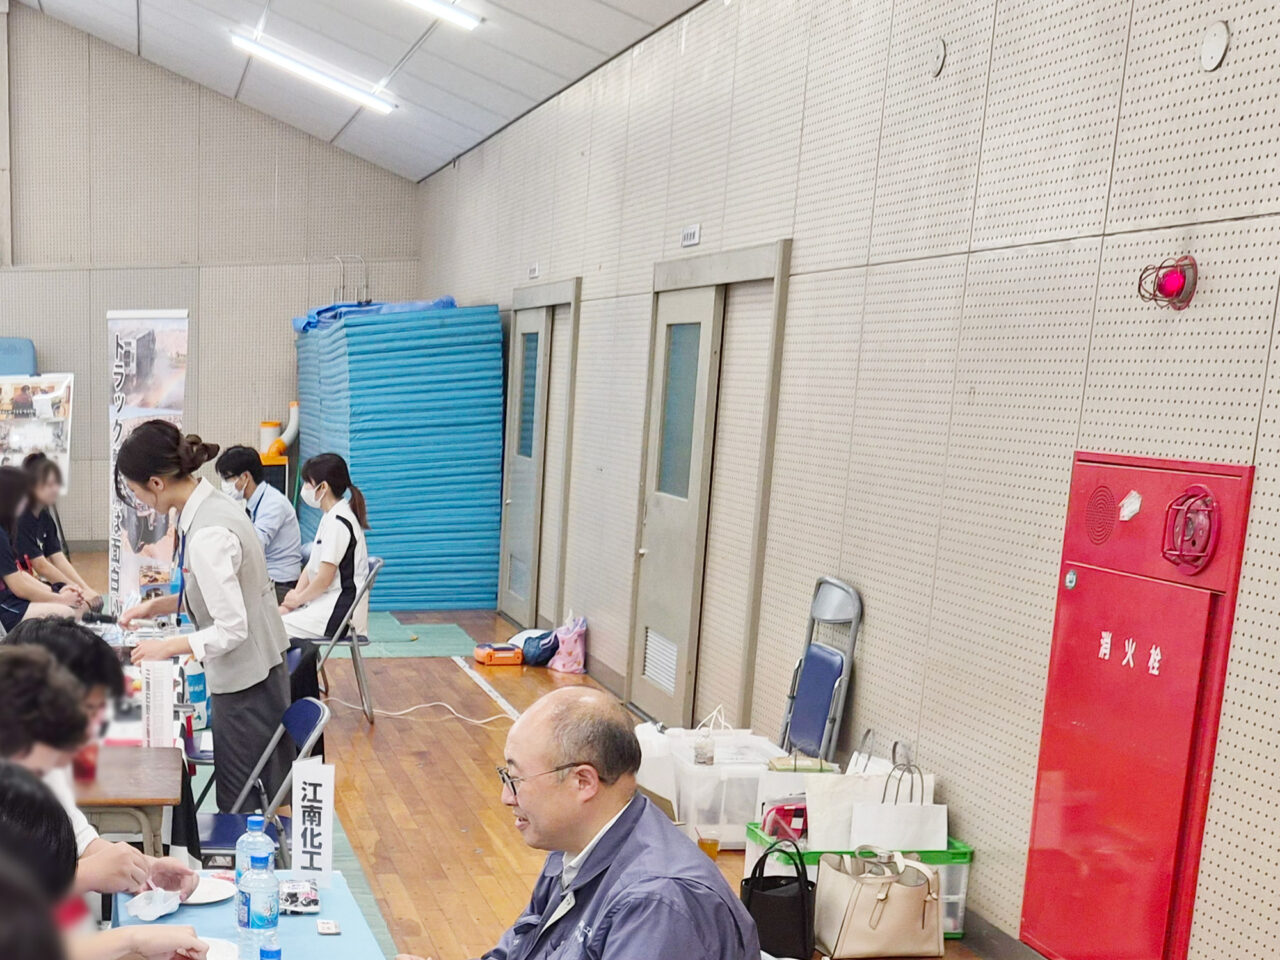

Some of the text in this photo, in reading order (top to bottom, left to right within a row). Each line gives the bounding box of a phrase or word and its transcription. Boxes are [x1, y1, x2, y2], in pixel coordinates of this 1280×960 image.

[1098, 631, 1162, 676] 消火栓
[300, 780, 323, 872] 江南化工
